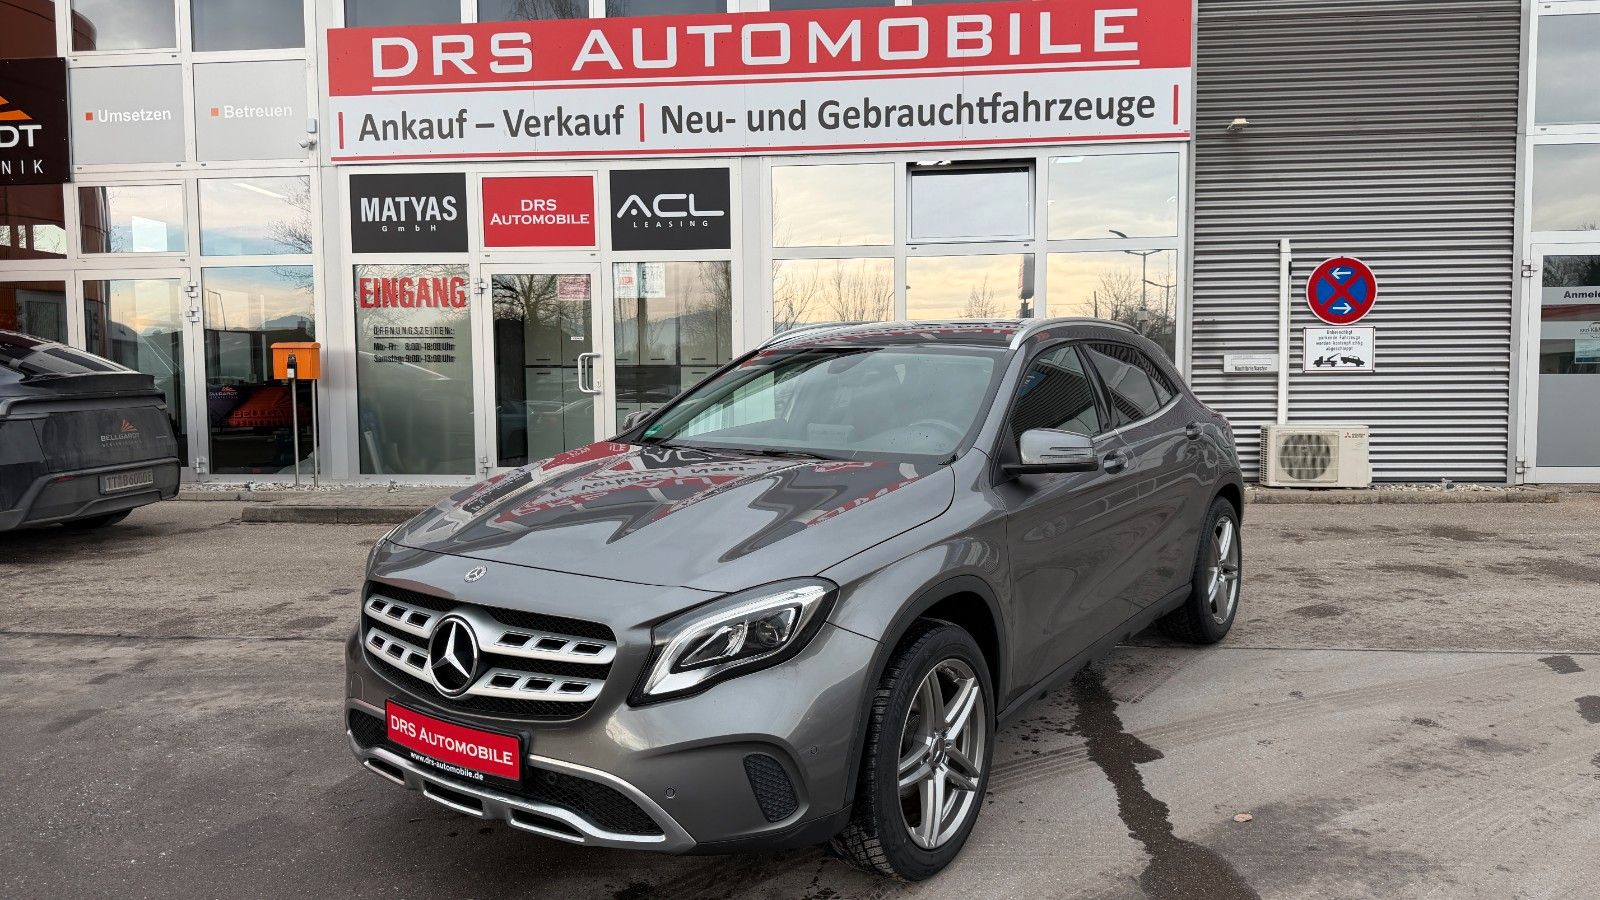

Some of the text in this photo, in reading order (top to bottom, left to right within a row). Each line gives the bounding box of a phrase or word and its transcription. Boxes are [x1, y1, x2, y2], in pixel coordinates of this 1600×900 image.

[371, 8, 1139, 78] DRS AUTOMOBILE
[97, 108, 172, 123] Umsetzen
[223, 104, 293, 119] Betreuen
[358, 109, 468, 142] Ankauf
[502, 105, 625, 138] Verkauf
[661, 103, 737, 134] Neu-
[746, 99, 807, 133] und
[817, 91, 1156, 130] Gebrauchtfahrzeuge
[360, 195, 458, 223] MATYAS
[520, 198, 557, 212] DRS
[616, 193, 725, 219] ACL
[381, 224, 437, 232] GmbH
[489, 213, 590, 226] AUTOMOBILE
[632, 219, 709, 229] LEASING
[359, 276, 467, 309] EINGANG
[390, 714, 514, 766] DRS AUTOMOBILE
[410, 751, 484, 781] www.drs-automobile.de
